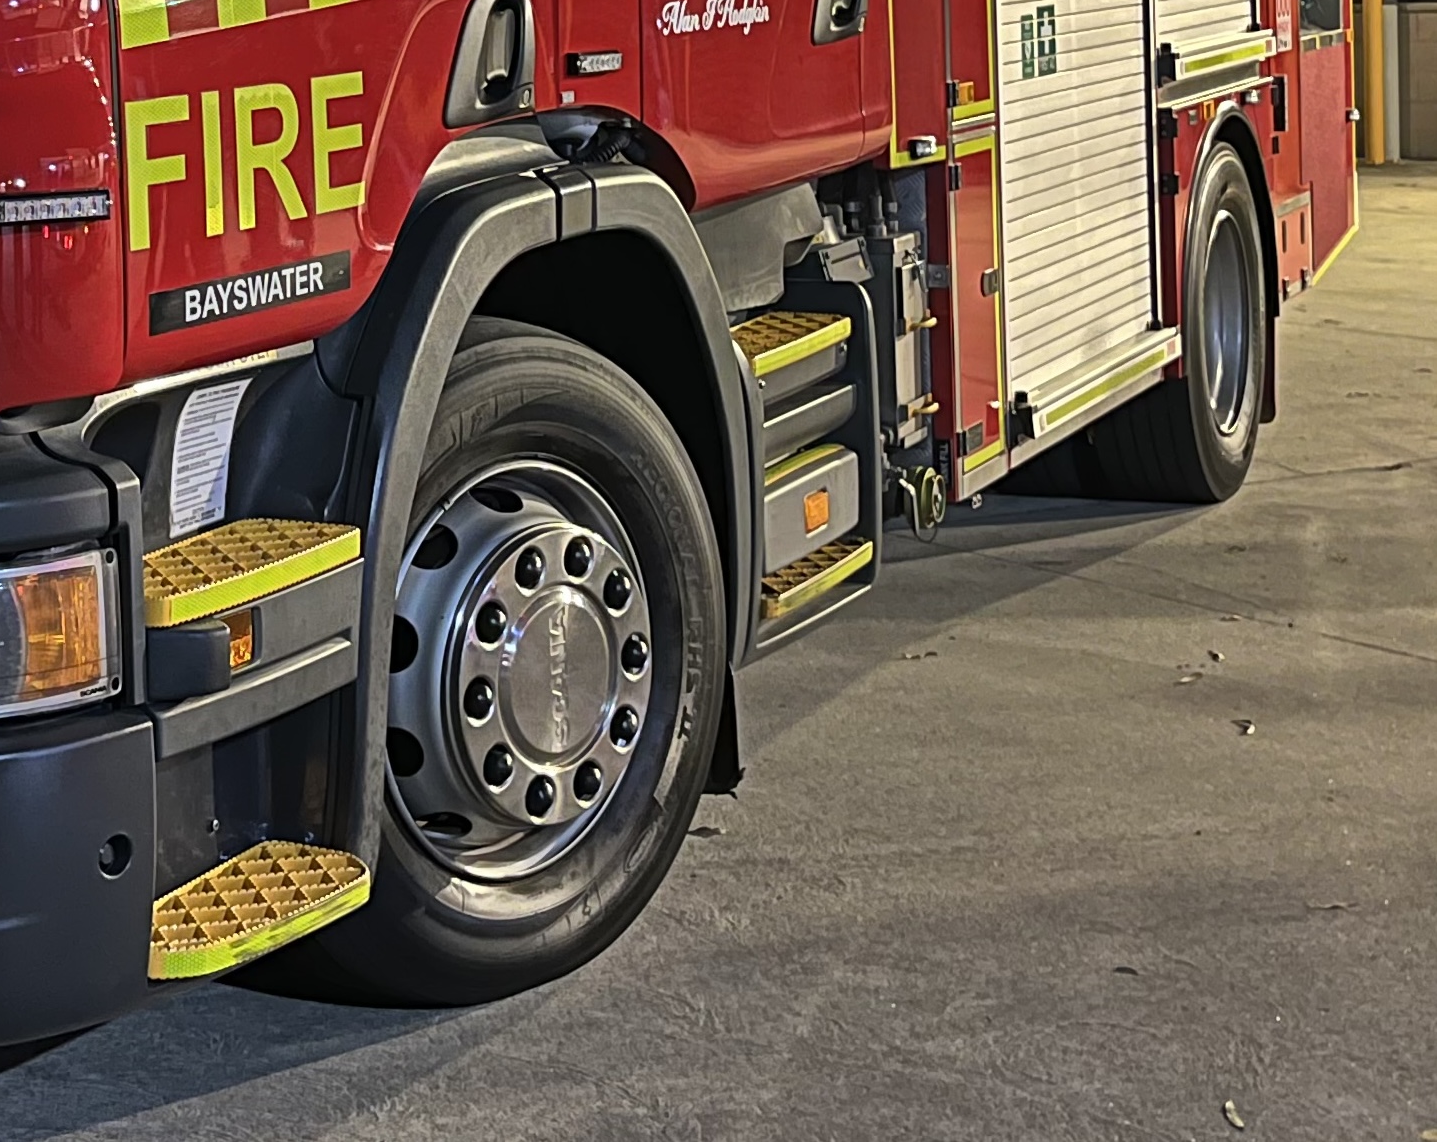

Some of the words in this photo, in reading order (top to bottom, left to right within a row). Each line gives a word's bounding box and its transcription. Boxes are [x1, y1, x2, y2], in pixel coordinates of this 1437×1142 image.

[662, 0, 700, 36] Alan
[125, 71, 365, 252] FIRE
[185, 261, 324, 322] BAYSWATER
